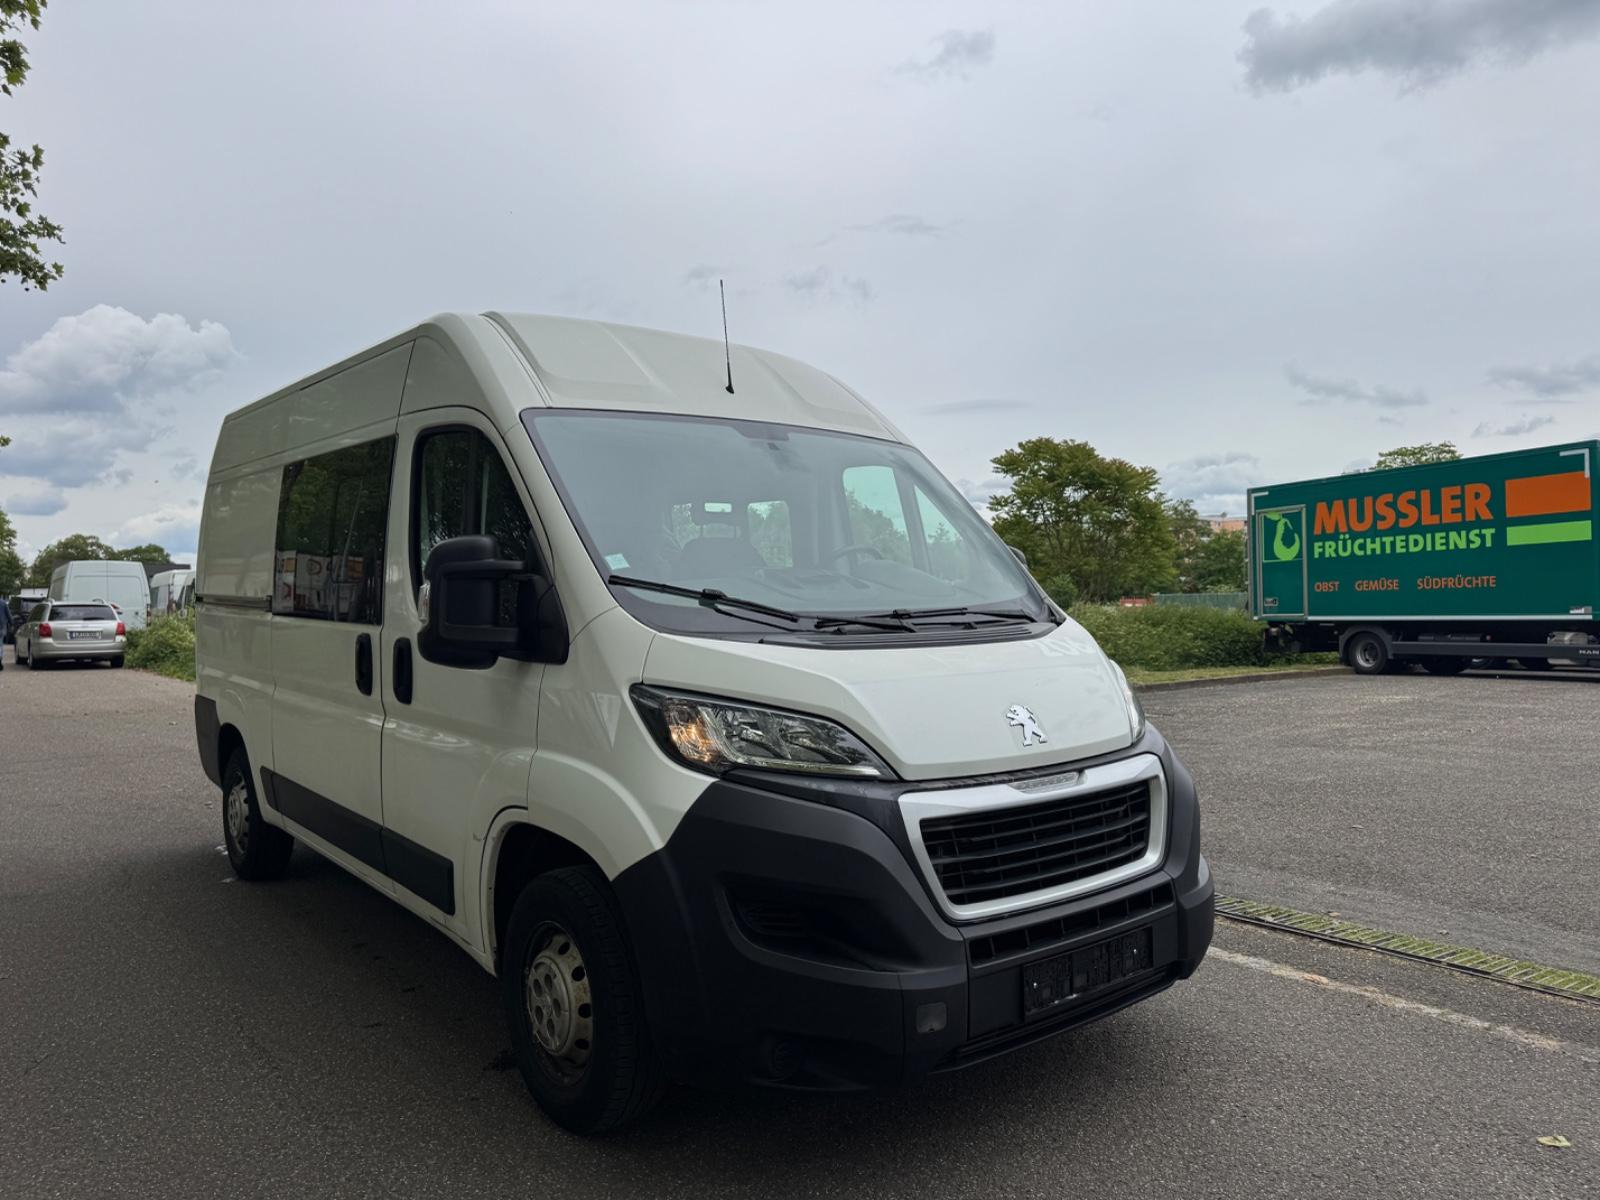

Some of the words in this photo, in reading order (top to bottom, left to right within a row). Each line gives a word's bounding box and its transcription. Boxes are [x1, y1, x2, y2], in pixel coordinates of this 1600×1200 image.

[1313, 483, 1493, 536] MUSSLER
[1313, 528, 1495, 559] FRÜCHTEDIENST
[1314, 581, 1340, 593] OBST
[1355, 577, 1399, 592] GEMÜSE
[1416, 574, 1497, 590] SÜDFRÜCHTE
